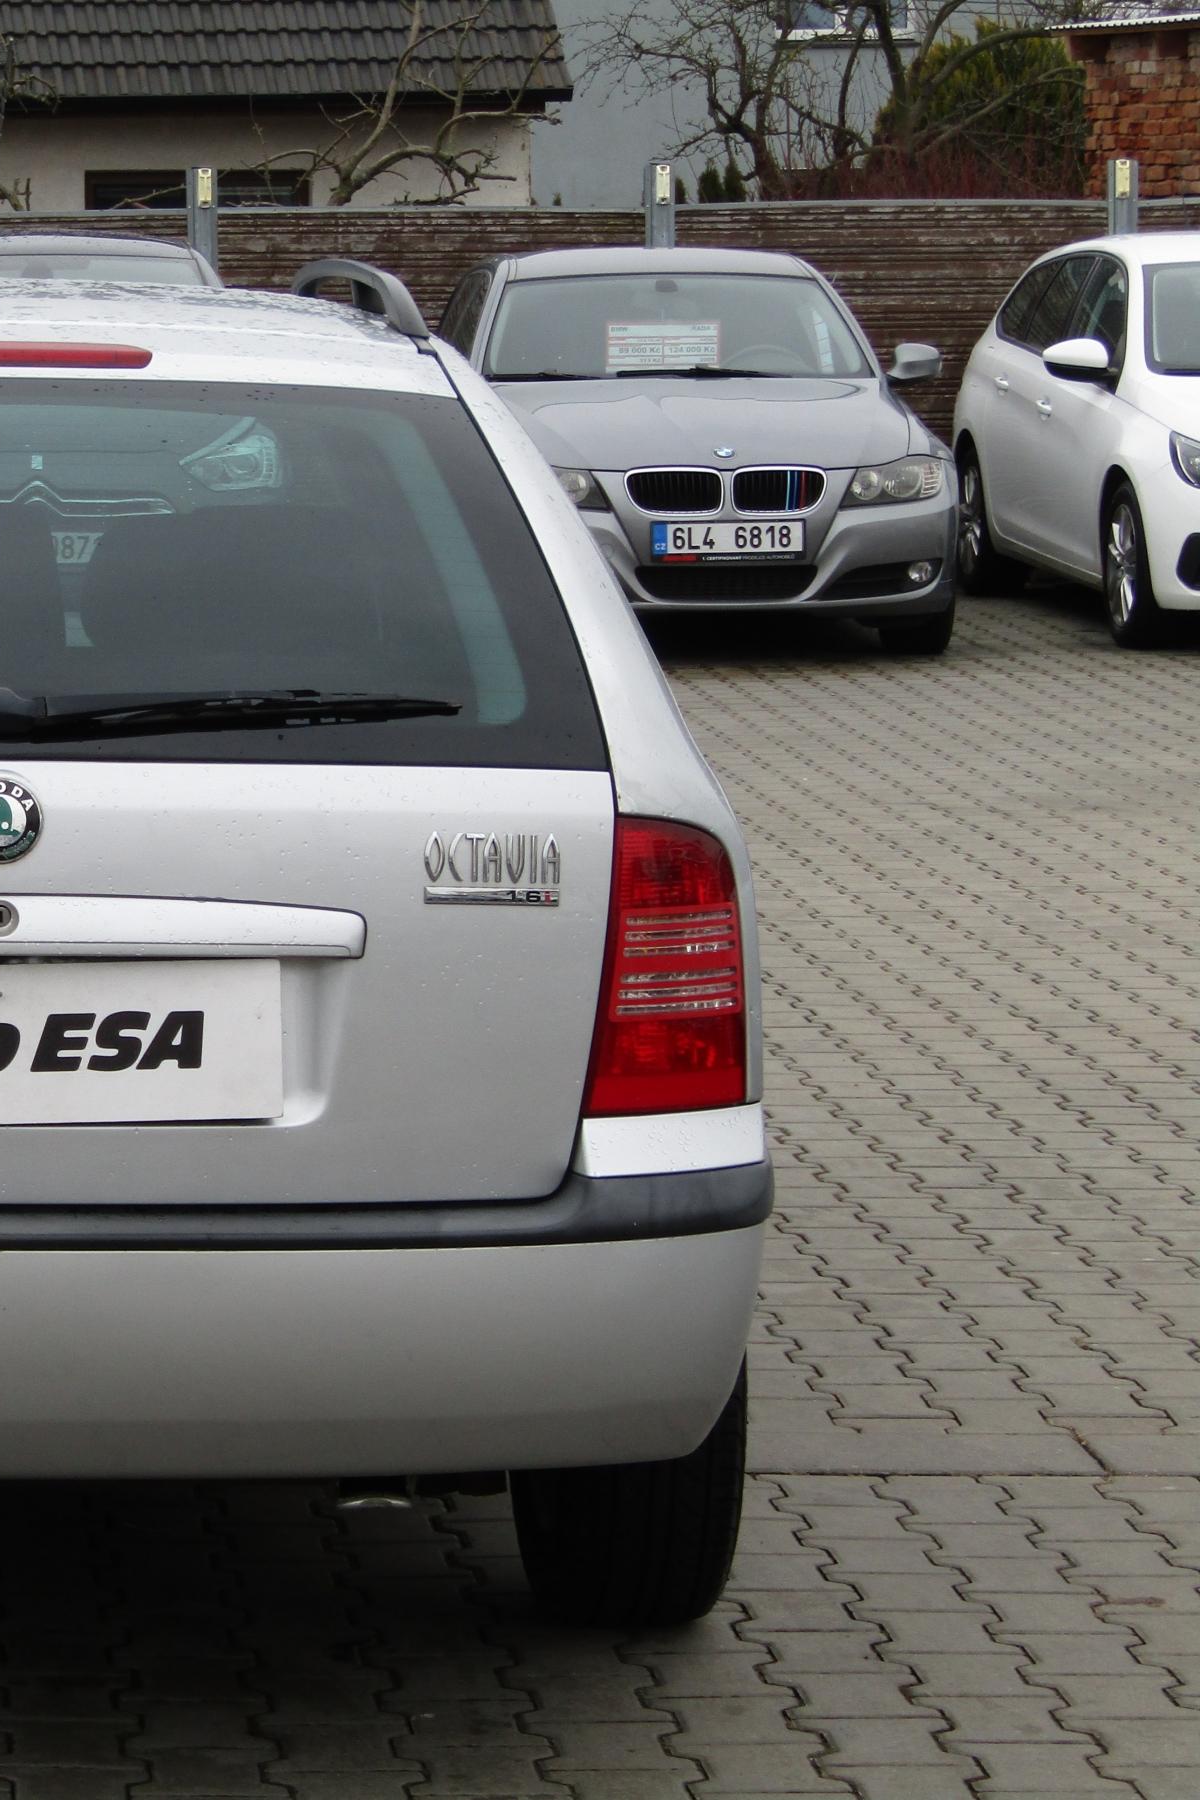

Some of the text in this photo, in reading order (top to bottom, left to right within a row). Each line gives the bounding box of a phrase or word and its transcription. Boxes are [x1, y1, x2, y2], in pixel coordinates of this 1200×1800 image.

[631, 346, 647, 354] 000
[686, 345, 701, 353] 000
[672, 525, 792, 550] 6L4 6818
[654, 543, 667, 551] CZ
[424, 830, 560, 884] OCTAVIA
[30, 1010, 205, 1073] ESA
